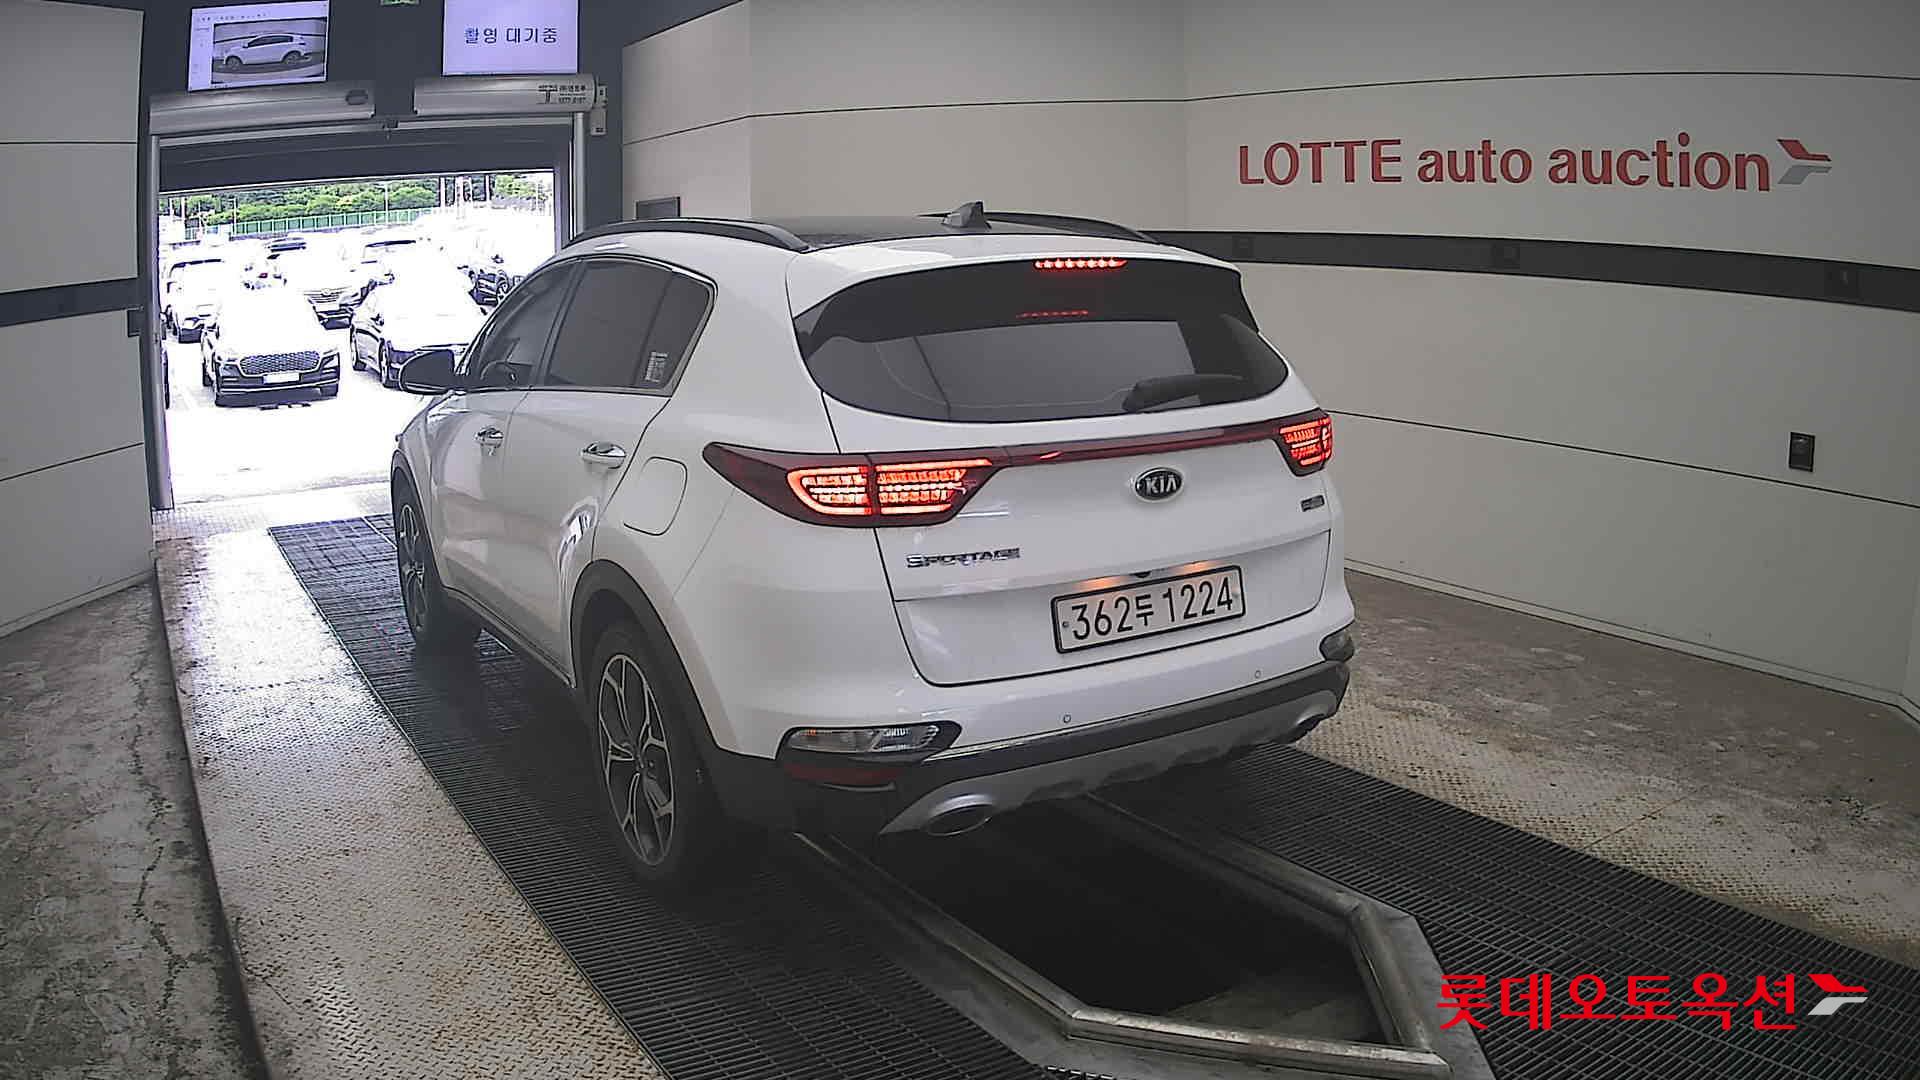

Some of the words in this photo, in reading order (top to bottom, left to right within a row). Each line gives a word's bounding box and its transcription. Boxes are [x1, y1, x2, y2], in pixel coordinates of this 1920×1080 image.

[505, 27, 557, 44] 대기중
[1238, 139, 1402, 186] LOTTE
[1416, 139, 1533, 184] auto
[1547, 131, 1771, 192] auction
[1144, 474, 1177, 496] KIA
[1071, 594, 1154, 640] 362두
[1162, 576, 1233, 623] 1224
